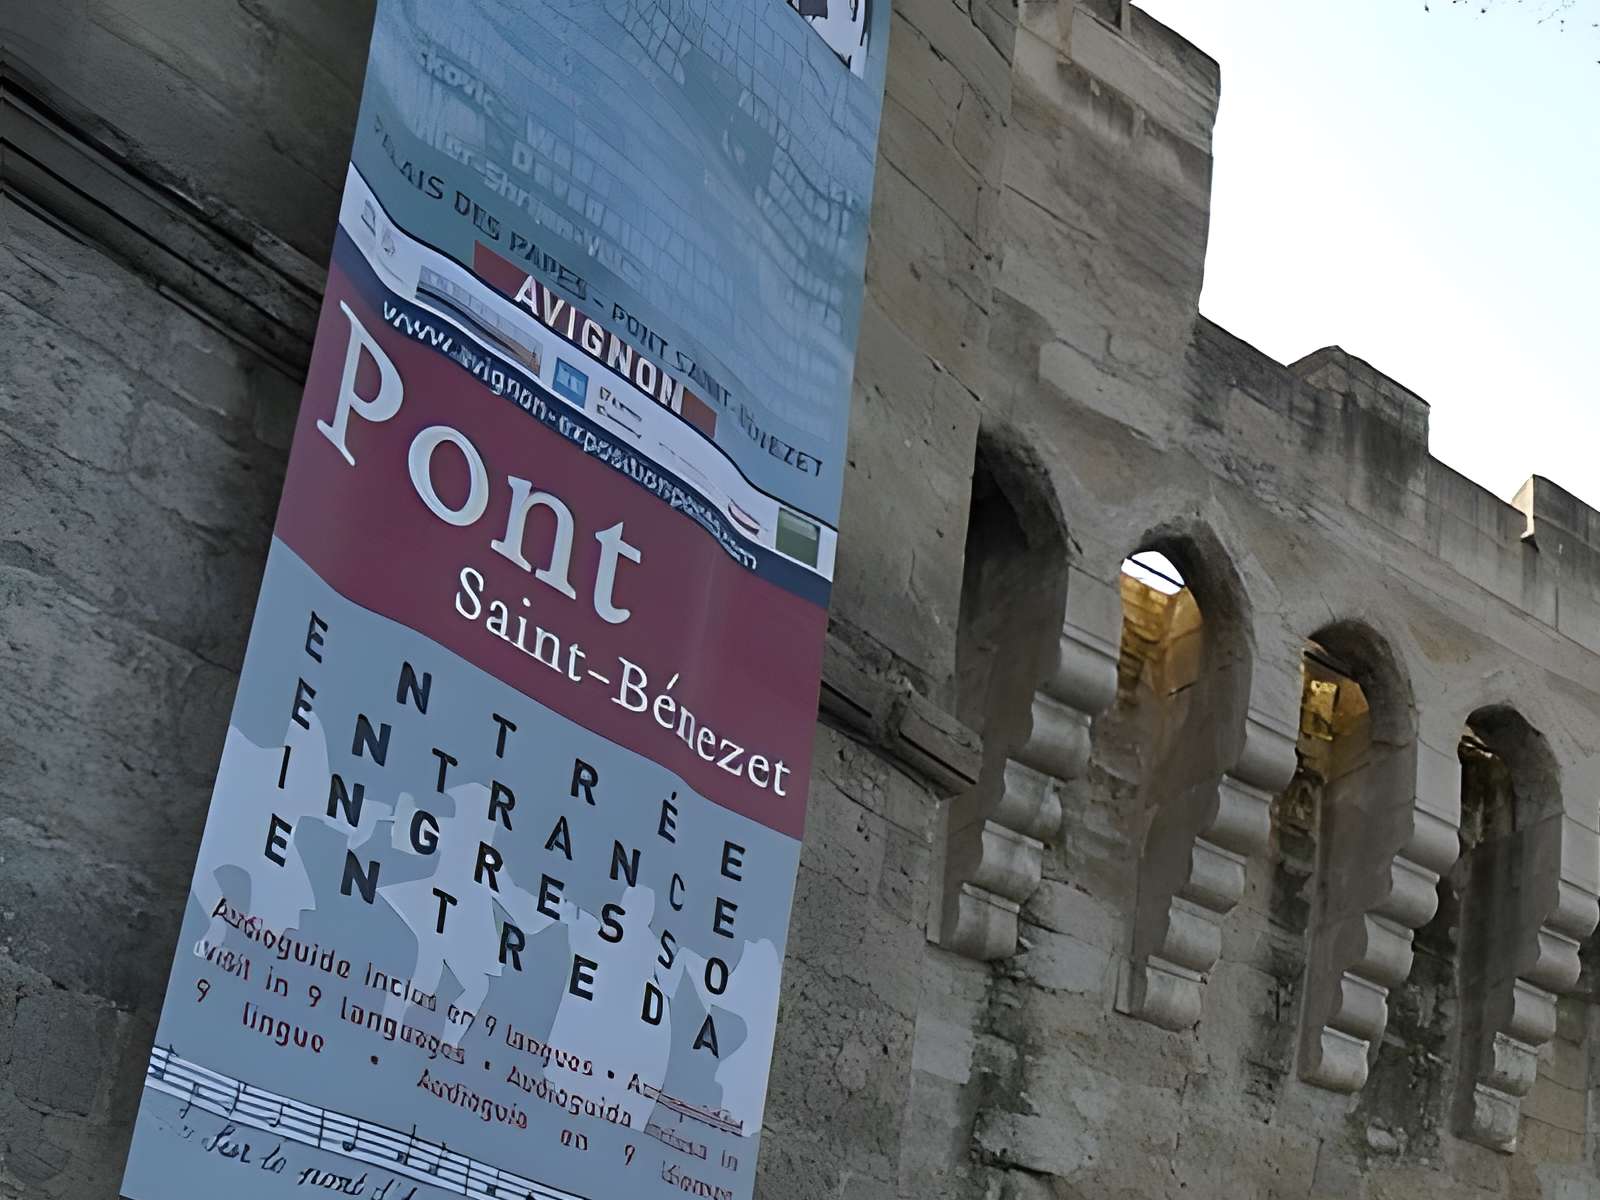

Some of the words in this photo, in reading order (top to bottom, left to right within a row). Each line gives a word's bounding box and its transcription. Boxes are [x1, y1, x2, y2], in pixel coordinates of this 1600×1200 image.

[514, 274, 685, 414] AVIGNON
[316, 300, 641, 624] Pont
[453, 565, 792, 797] Saint-Bénezet
[196, 978, 212, 1004] 9
[265, 965, 289, 997] in
[308, 984, 323, 1008] 9
[485, 1014, 498, 1037] 9
